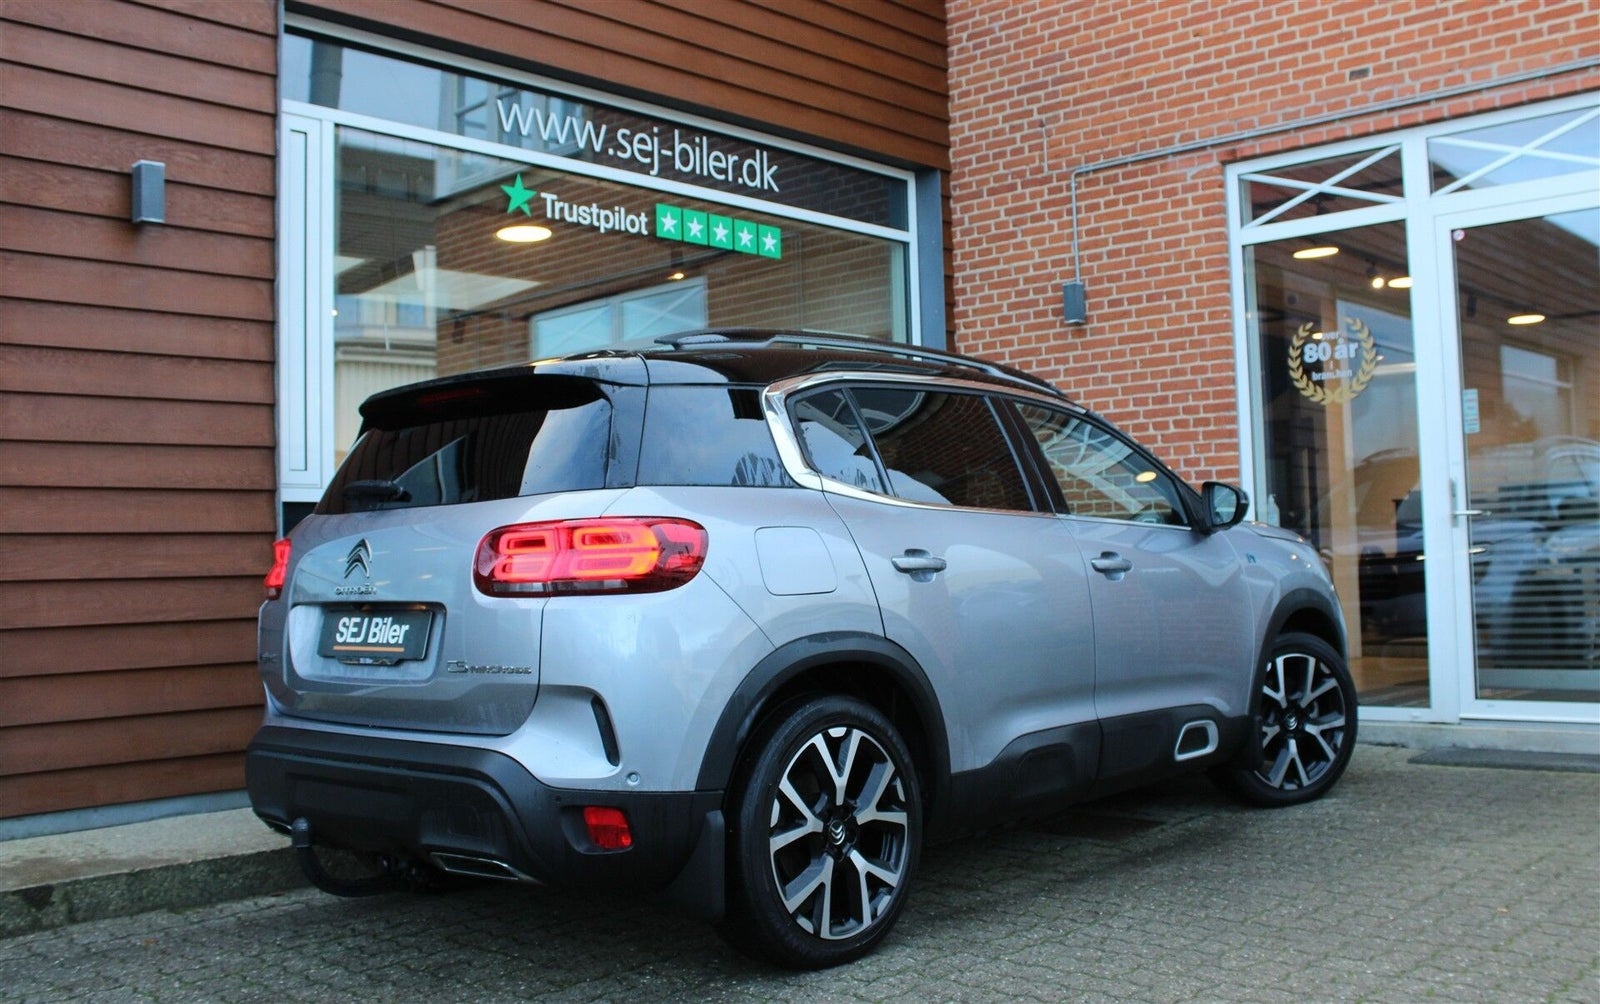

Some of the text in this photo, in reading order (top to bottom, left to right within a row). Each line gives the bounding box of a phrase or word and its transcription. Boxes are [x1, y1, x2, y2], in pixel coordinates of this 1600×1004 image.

[497, 99, 779, 193] www.sej-biler.dk
[541, 192, 648, 236] Trustpilot
[1303, 337, 1359, 363] 80 år
[335, 616, 410, 644] SEJ Biler
